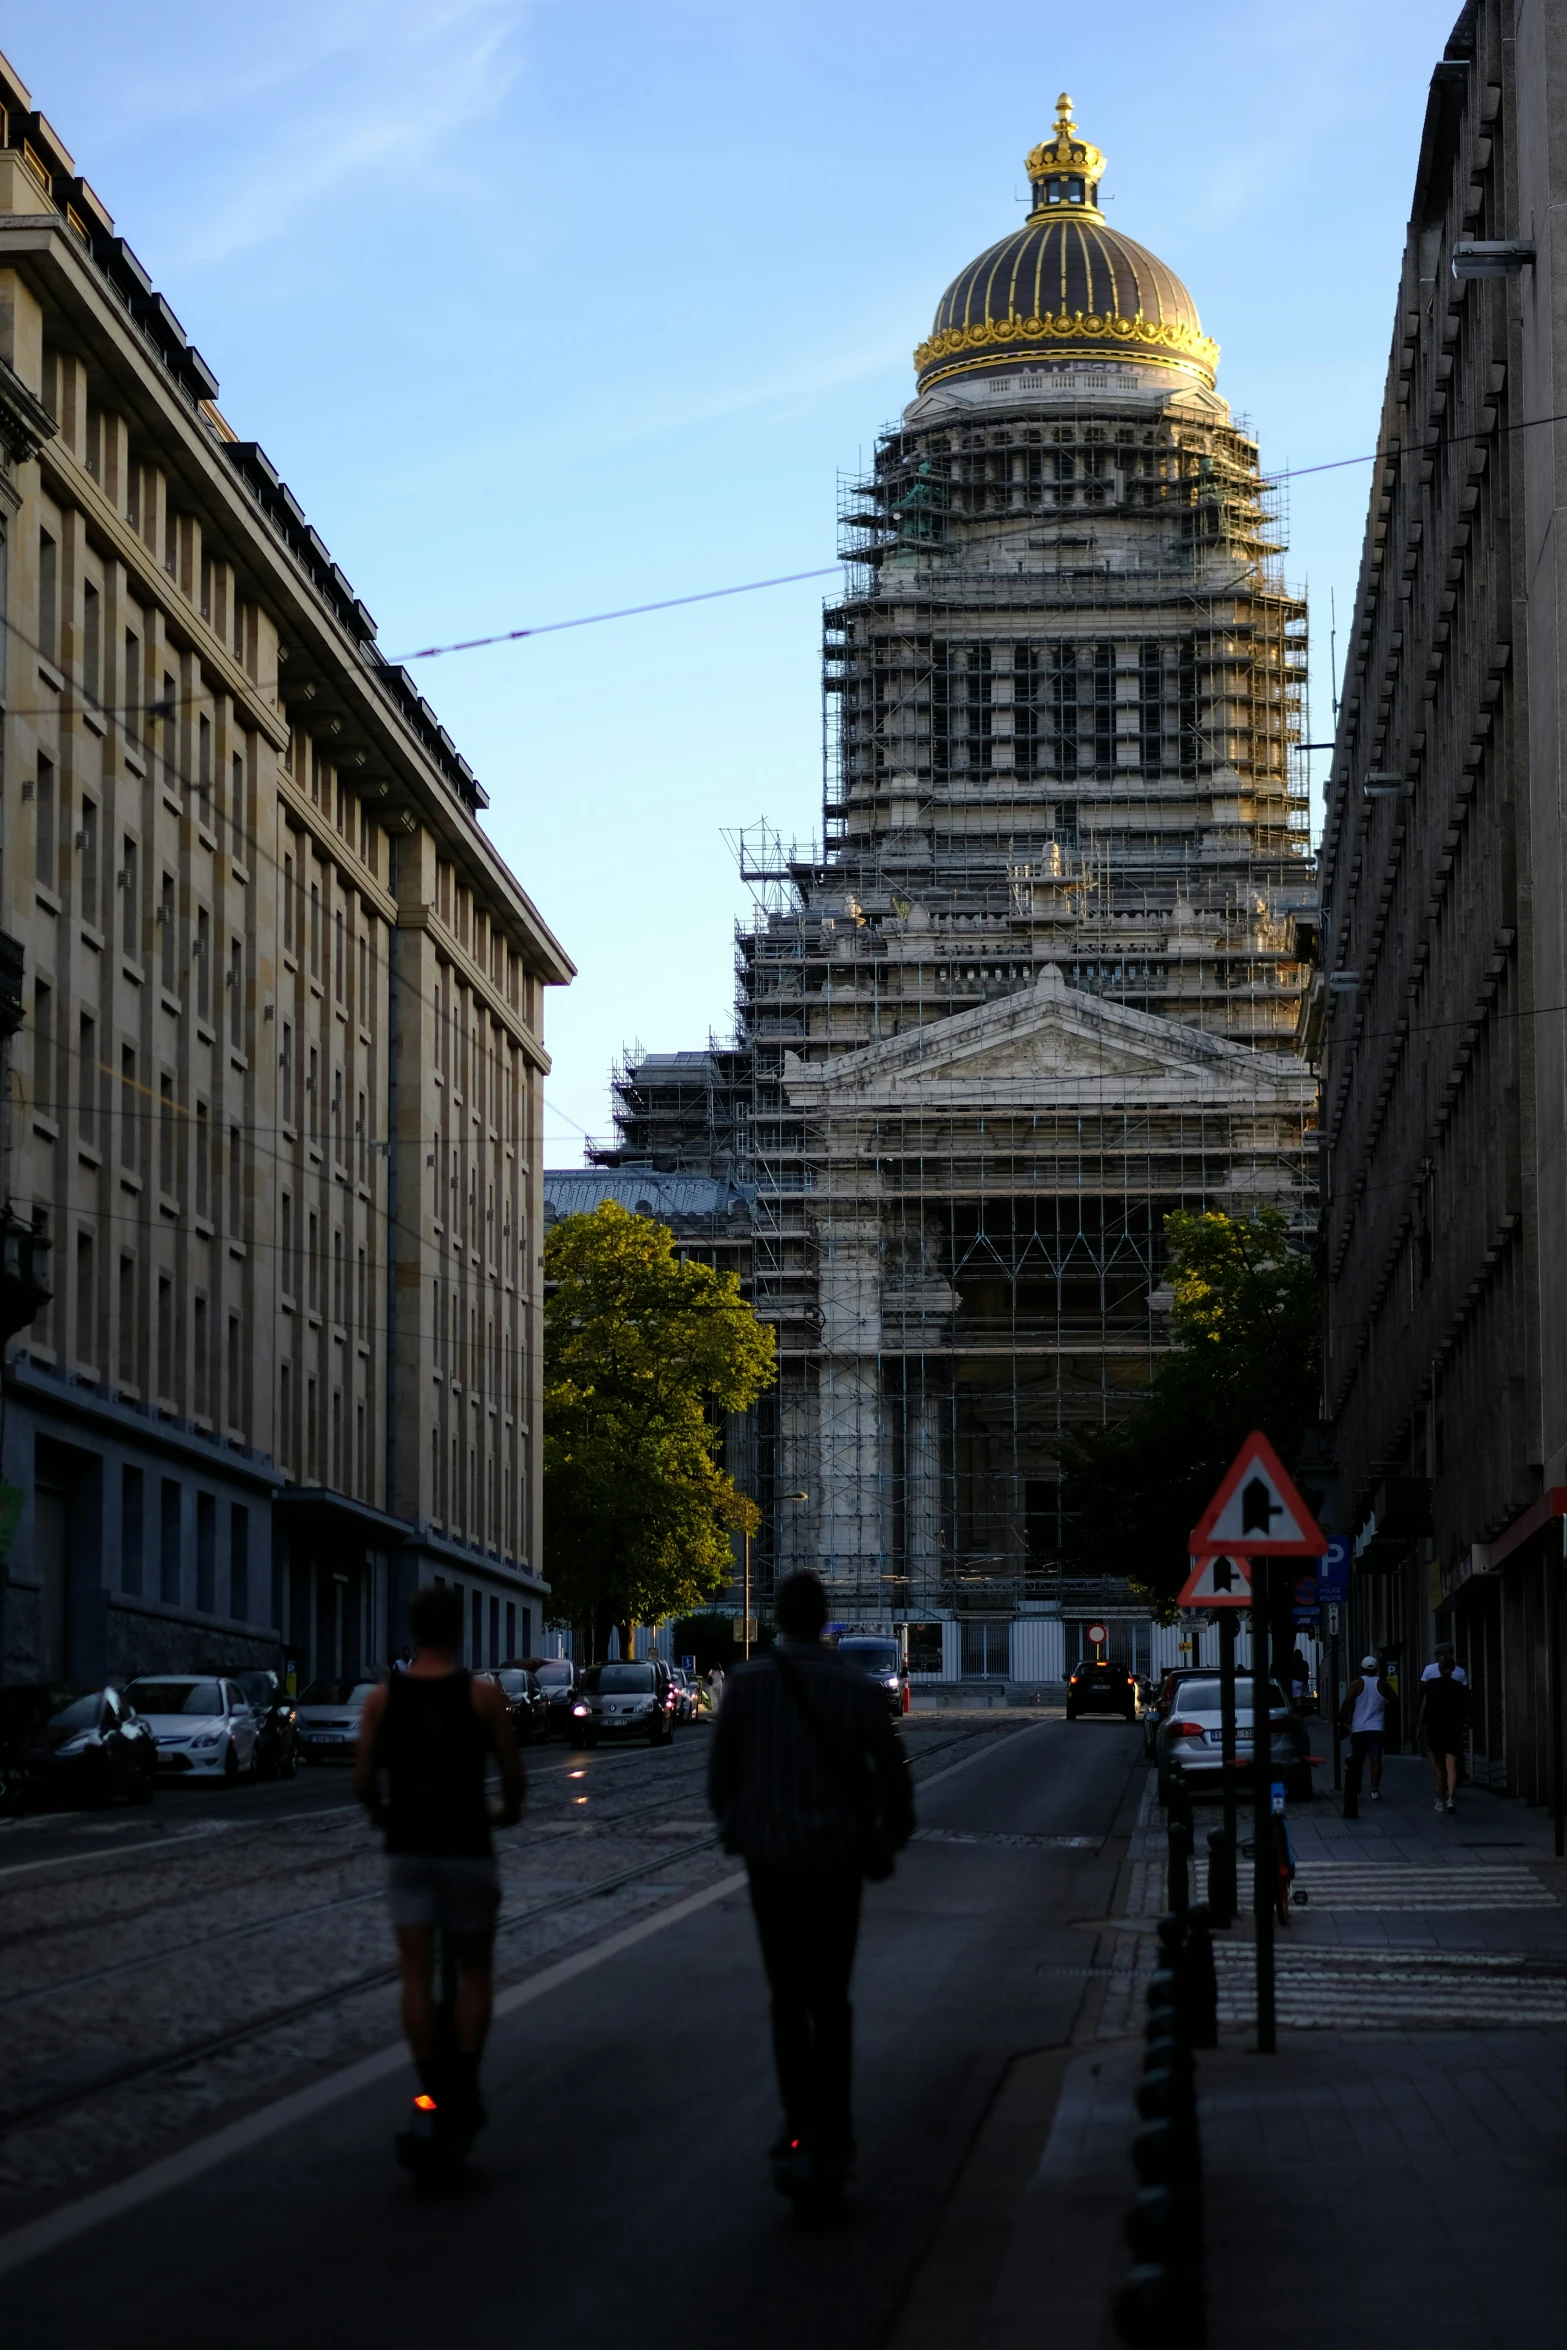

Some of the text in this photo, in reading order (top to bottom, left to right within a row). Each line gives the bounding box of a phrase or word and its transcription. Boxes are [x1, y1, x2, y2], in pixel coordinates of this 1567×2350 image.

[1321, 1543, 1345, 1577] P
[1320, 1586, 1341, 1594] POLICE
[1319, 1594, 1342, 1602] POLITIE
[1387, 1665, 1396, 1675] P
